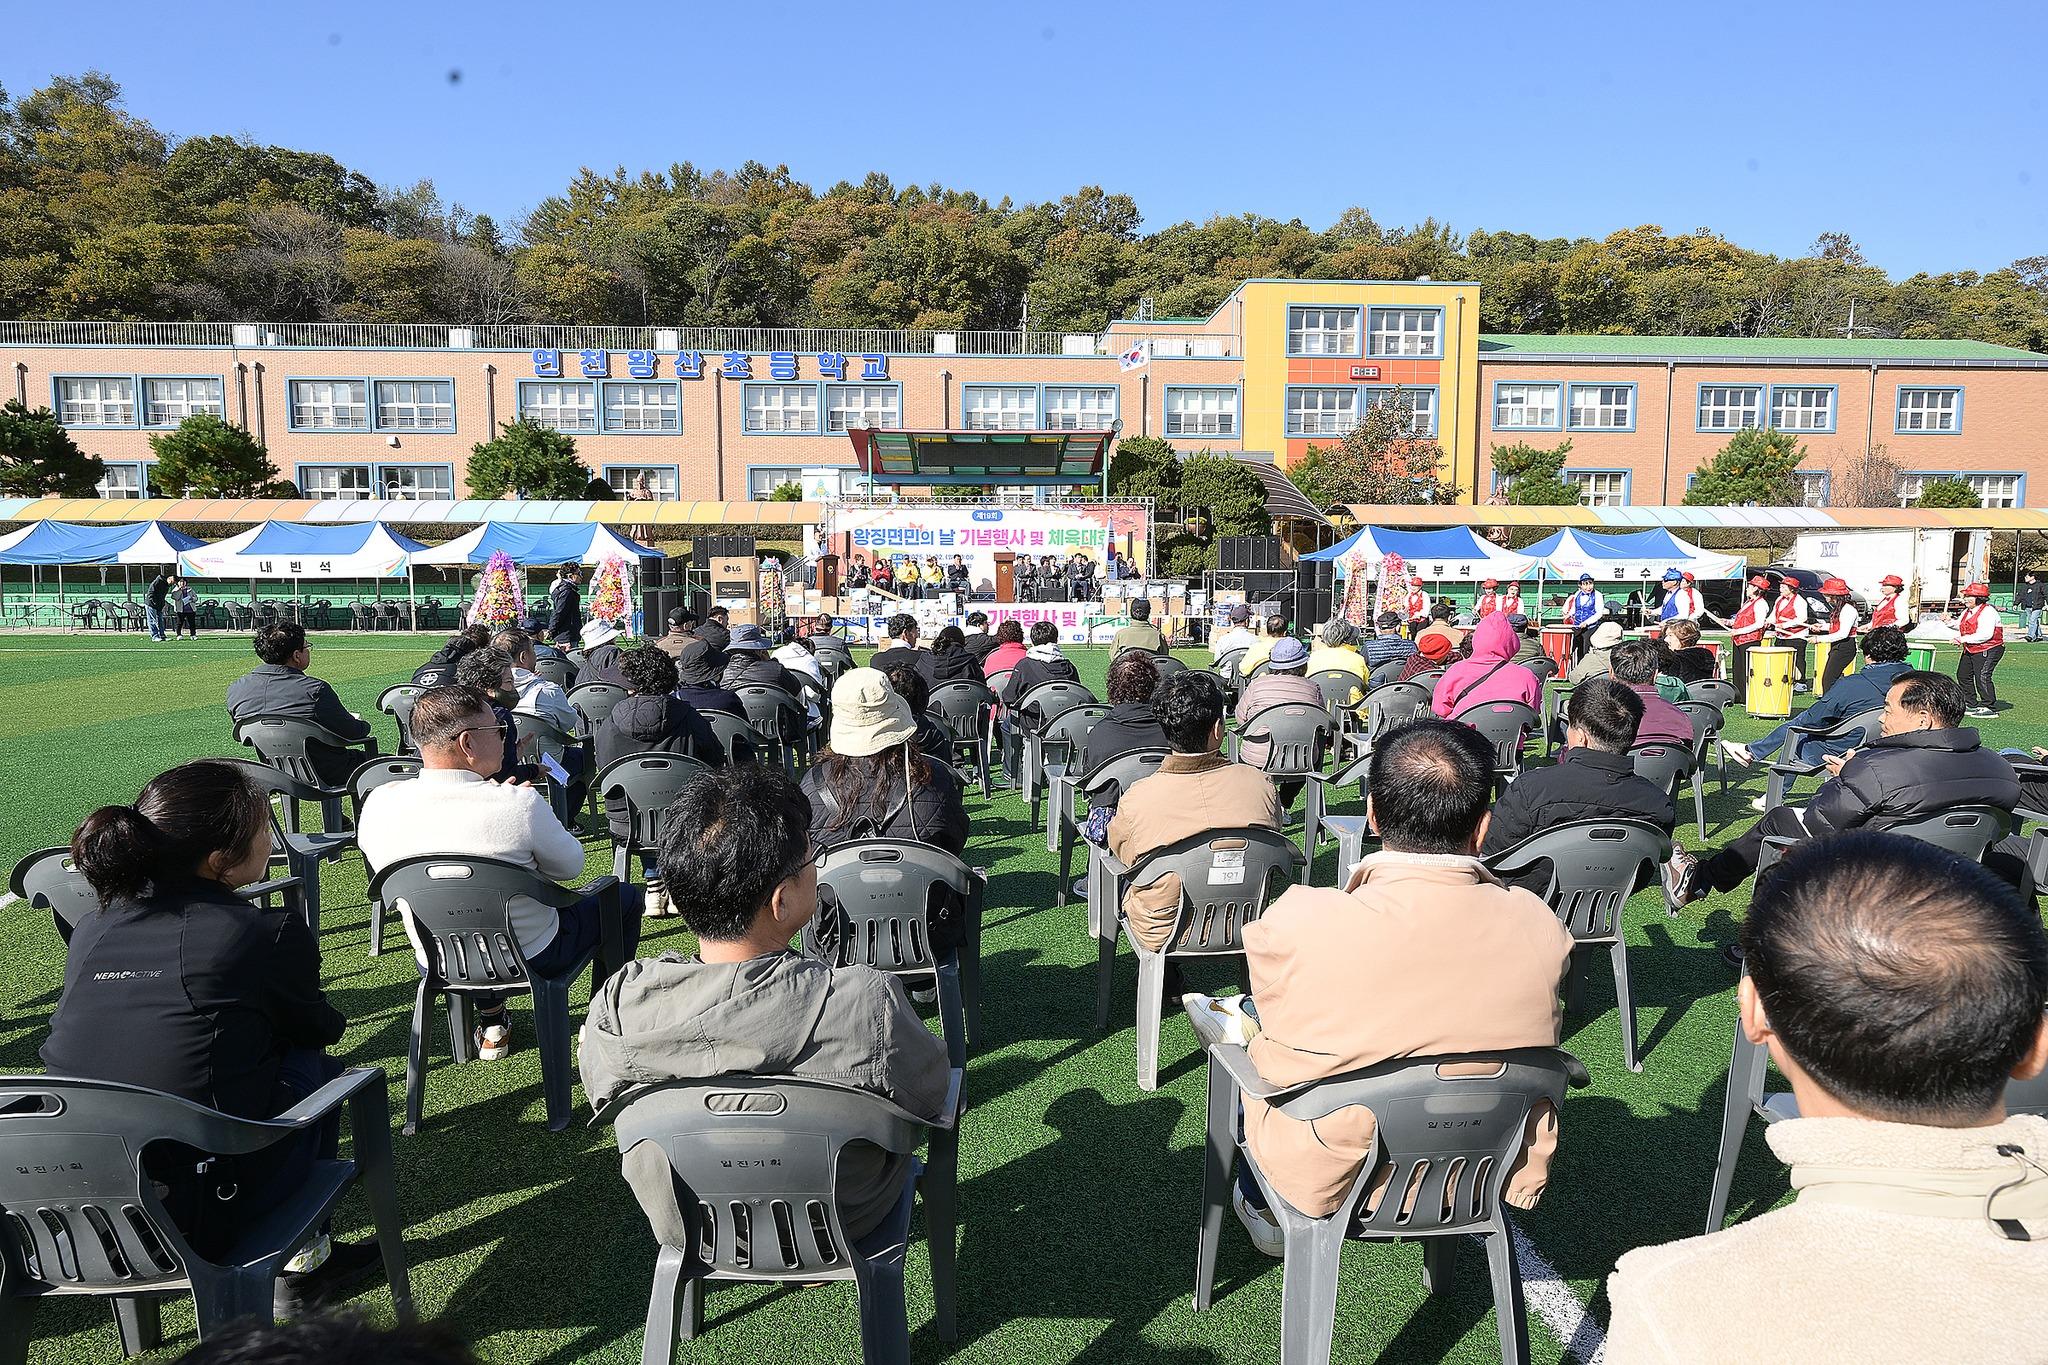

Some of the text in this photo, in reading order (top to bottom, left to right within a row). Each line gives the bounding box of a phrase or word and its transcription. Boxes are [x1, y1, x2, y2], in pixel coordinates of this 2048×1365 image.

[531, 348, 890, 381] 연천왕산초등학교
[976, 511, 998, 520] 제19회
[853, 528, 934, 546] 왕징면민의
[939, 528, 956, 546] 날
[960, 528, 1026, 546] 기념행사
[1030, 530, 1043, 546] 및
[259, 561, 332, 573] 내빈석
[1613, 567, 1652, 579] 접수
[1062, 611, 1077, 627] 및
[93, 970, 163, 980] NEPA ACTIVE
[1428, 1119, 1482, 1129] 일진기획
[16, 1162, 83, 1174] 일진기획
[720, 1158, 781, 1168] 일진기획
